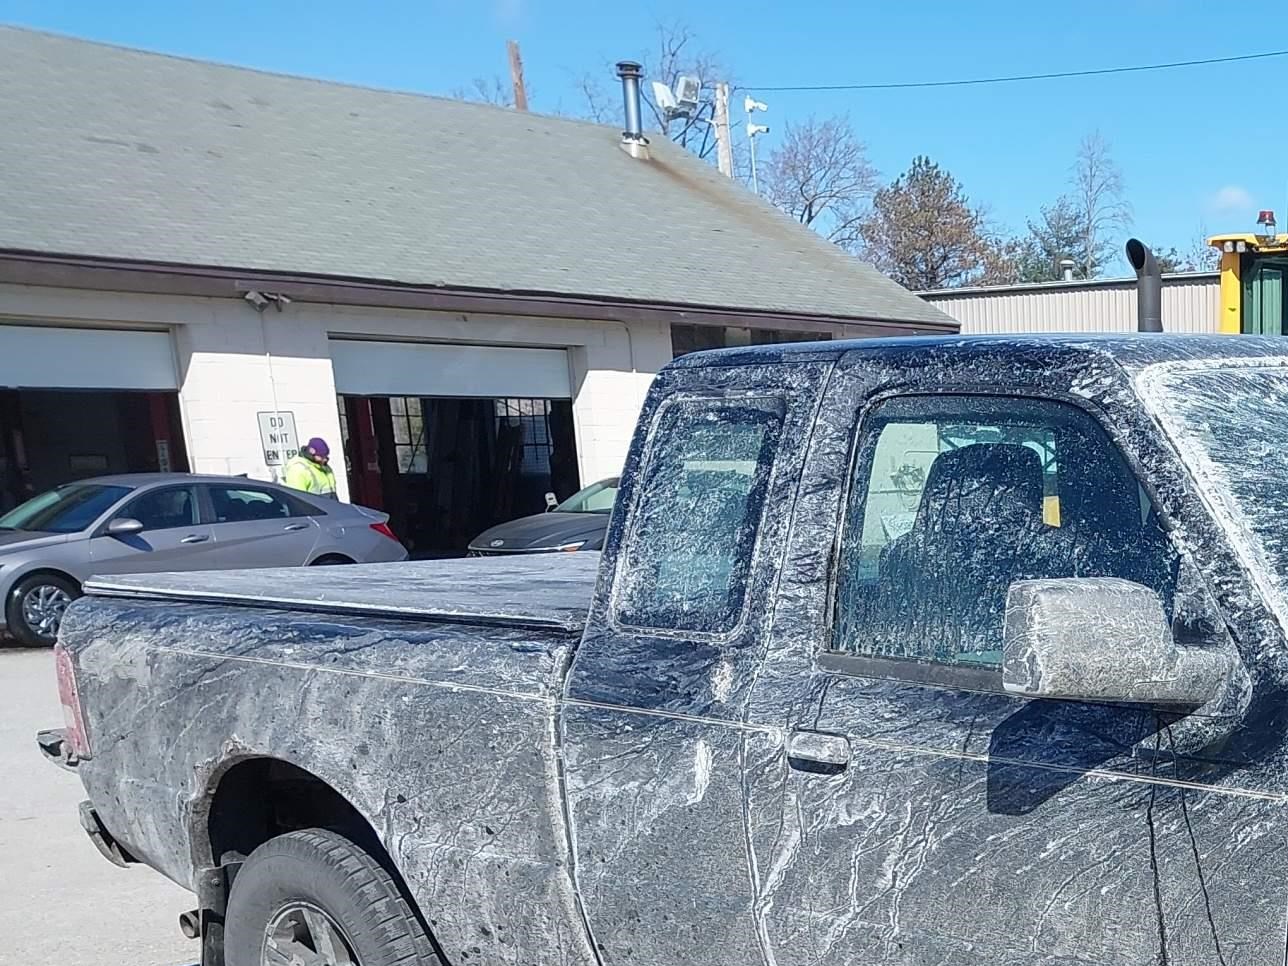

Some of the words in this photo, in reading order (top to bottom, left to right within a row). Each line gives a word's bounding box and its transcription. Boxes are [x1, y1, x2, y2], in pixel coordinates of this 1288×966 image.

[269, 416, 284, 428] DO
[269, 432, 288, 444] NOT
[266, 449, 298, 461] ENER
